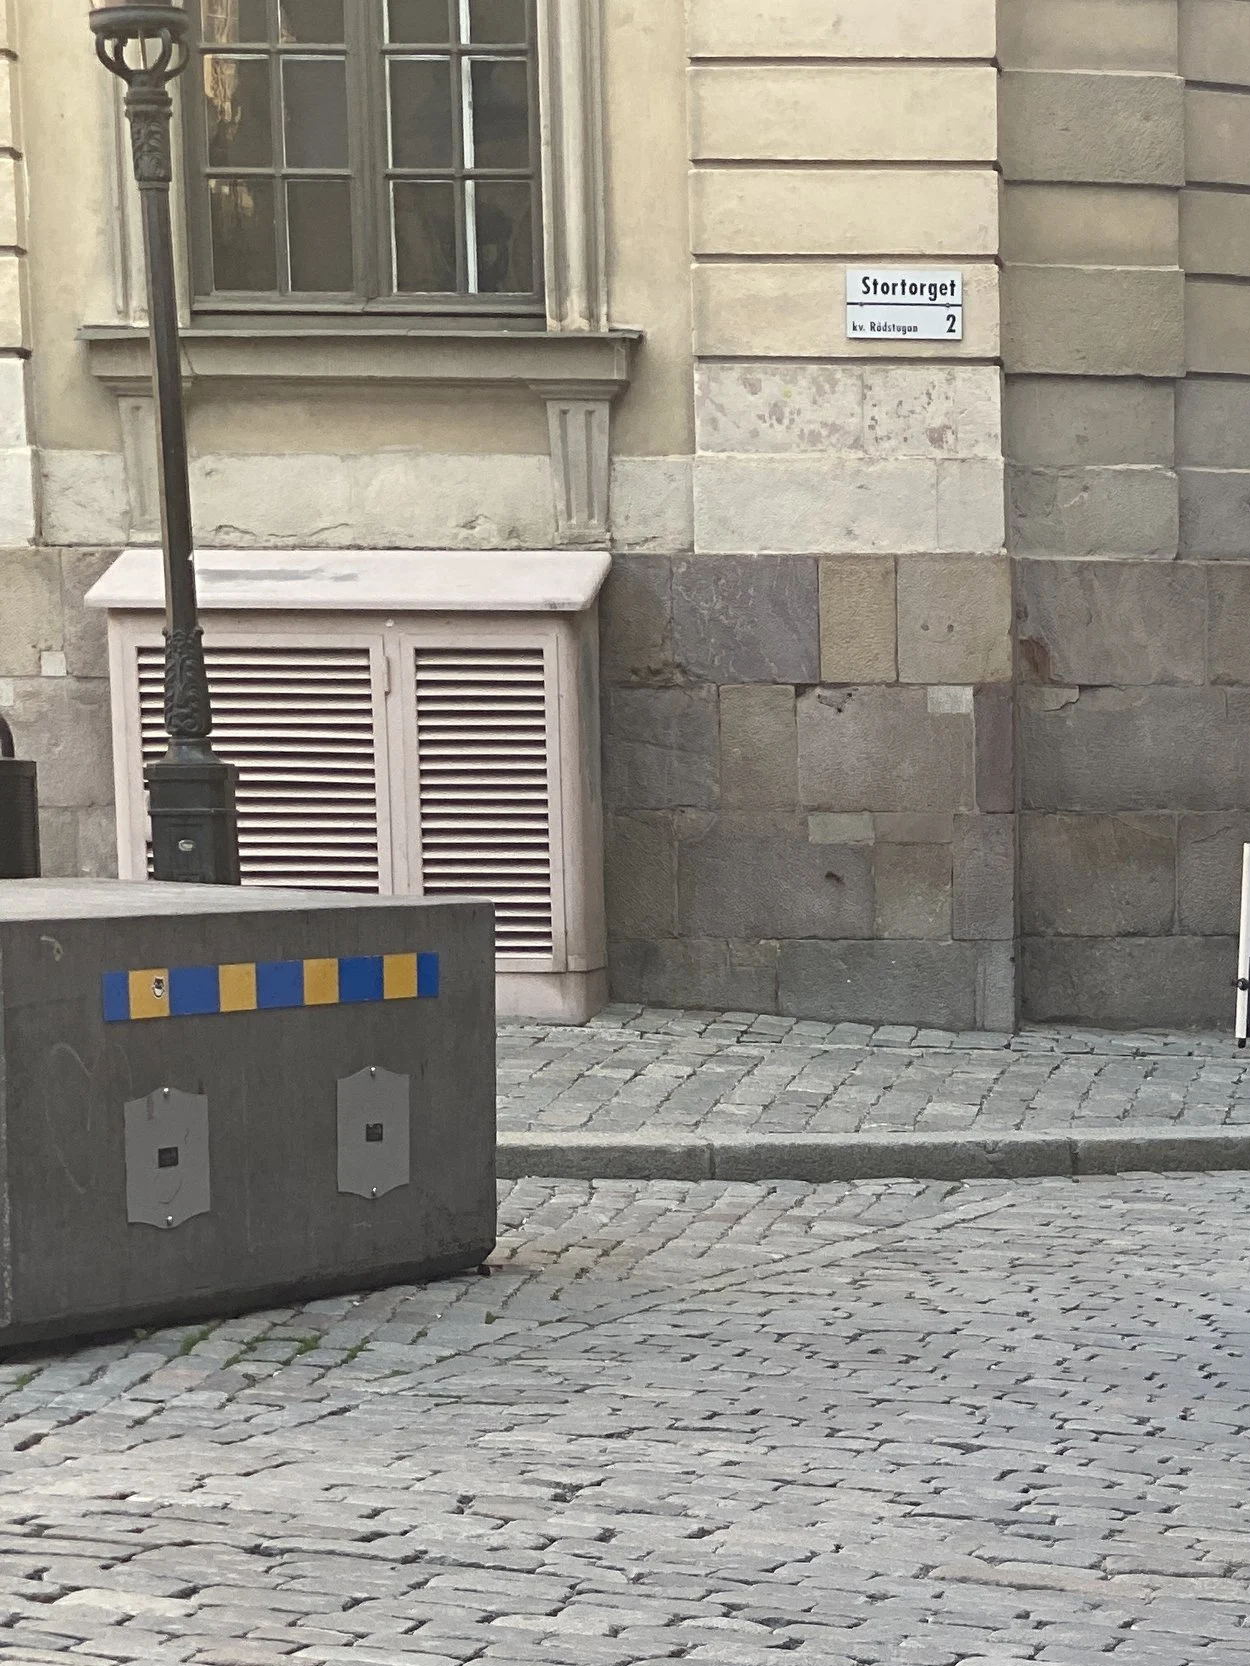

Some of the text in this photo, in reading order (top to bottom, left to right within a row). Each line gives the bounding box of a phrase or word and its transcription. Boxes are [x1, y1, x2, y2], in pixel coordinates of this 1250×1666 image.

[861, 276, 956, 301] Stortorget
[852, 321, 866, 332] kv.
[946, 314, 956, 333] 2
